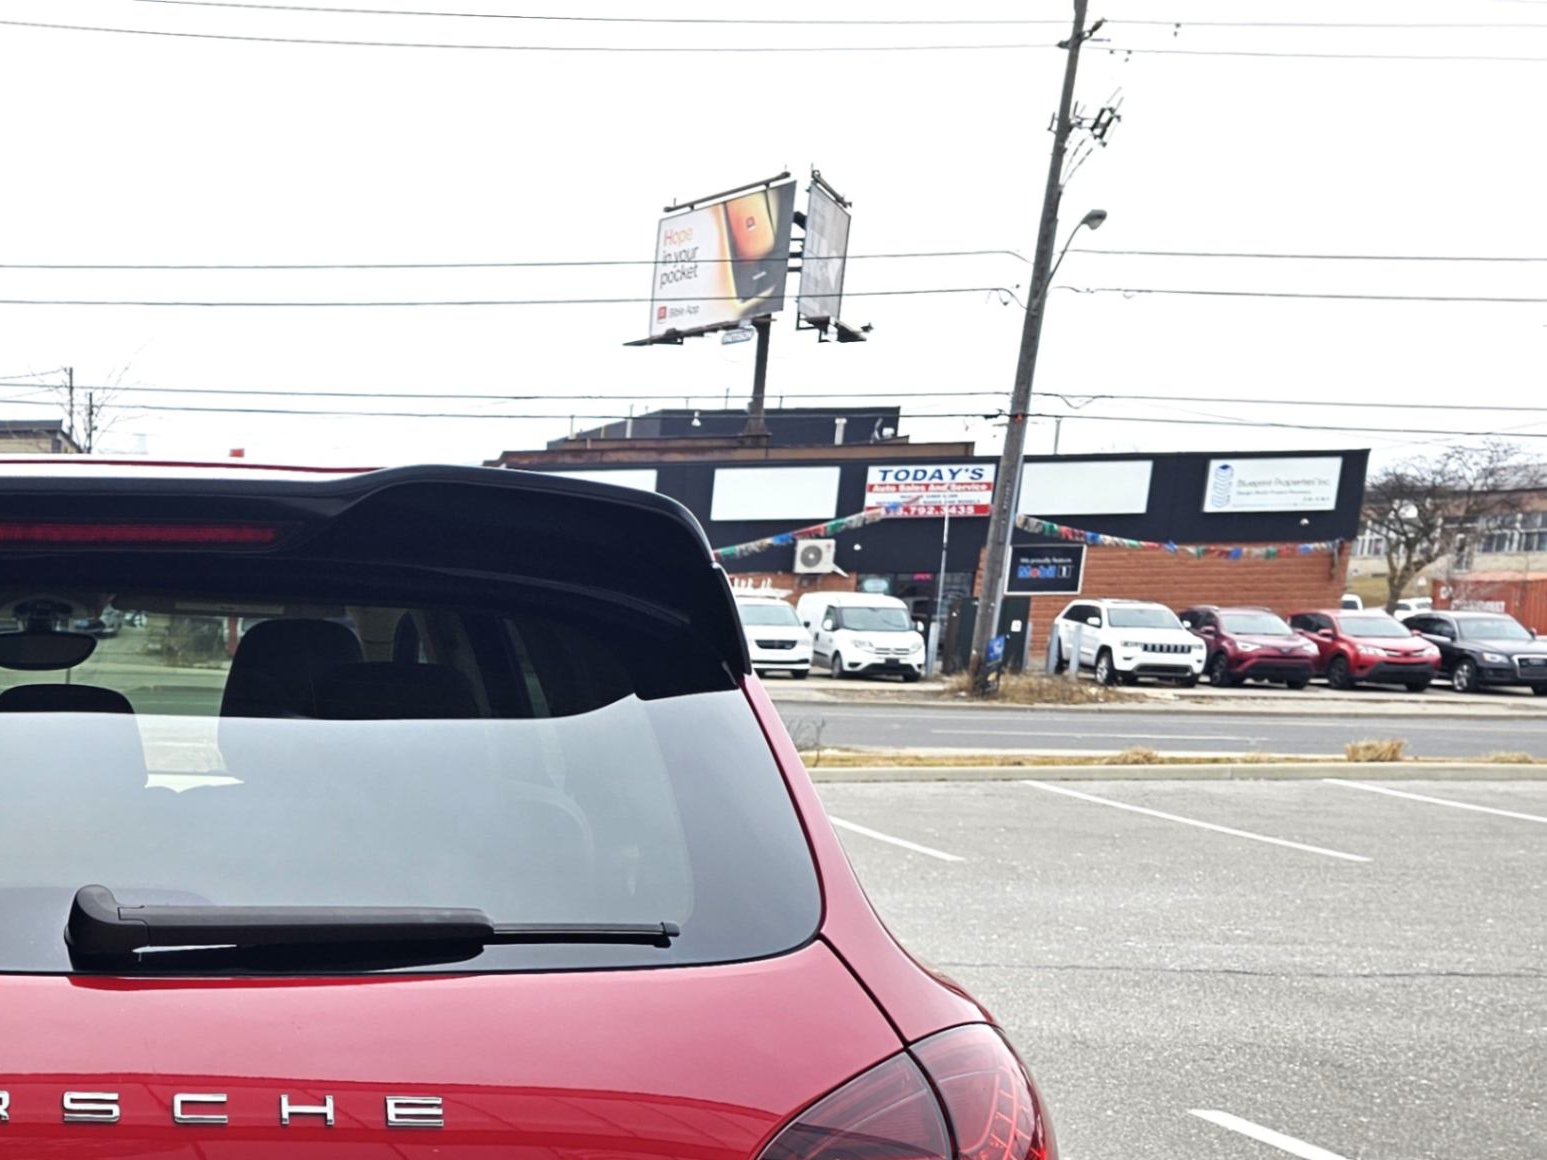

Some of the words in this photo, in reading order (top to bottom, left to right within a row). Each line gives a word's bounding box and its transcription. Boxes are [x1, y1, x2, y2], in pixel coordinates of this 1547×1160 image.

[663, 226, 693, 247] Hope
[662, 249, 673, 267] in
[673, 245, 700, 268] your
[659, 263, 699, 289] pocket
[878, 467, 985, 482] TODAY'S
[872, 483, 896, 492] Auto
[899, 483, 926, 492] Sales
[928, 483, 948, 492] And
[950, 482, 988, 491] Service
[1017, 565, 1057, 578] Mobil
